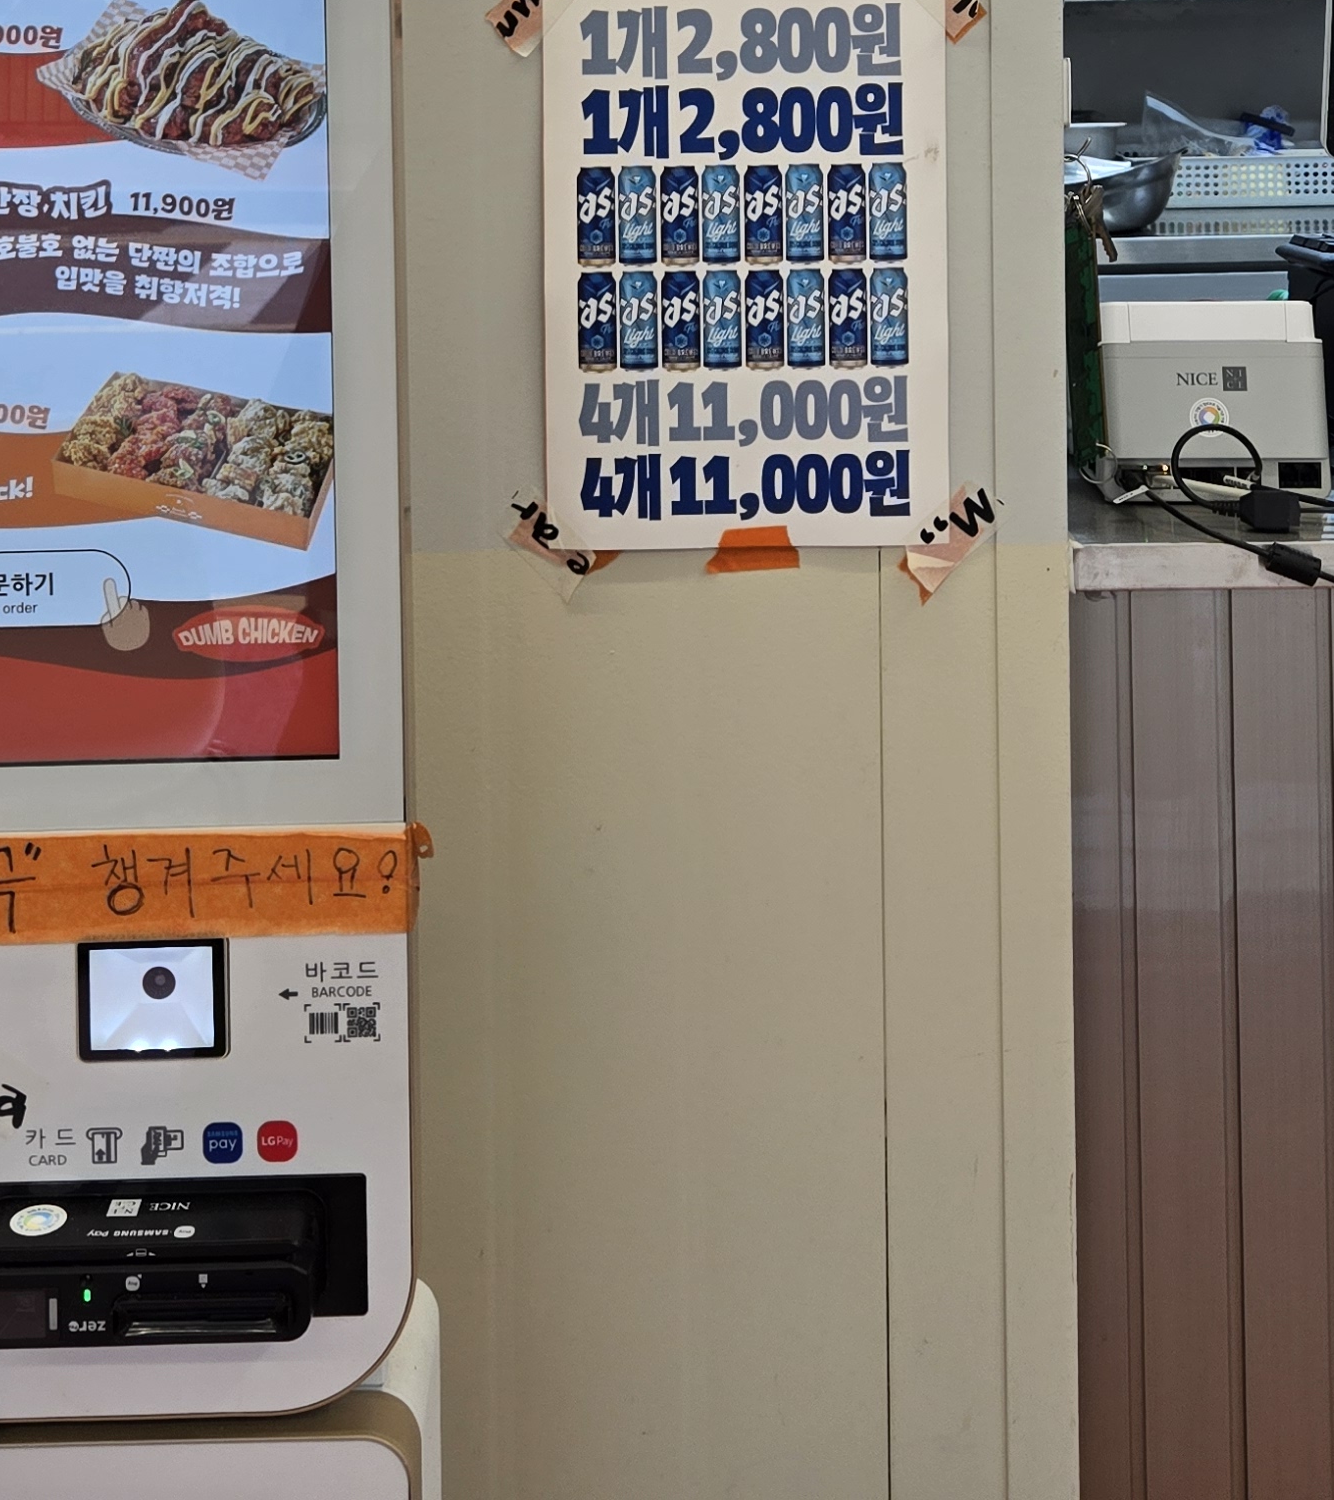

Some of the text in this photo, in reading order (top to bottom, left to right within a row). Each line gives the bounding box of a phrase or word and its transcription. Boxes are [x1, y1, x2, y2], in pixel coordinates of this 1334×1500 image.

[579, 2, 903, 81] 1개 2,800원
[581, 81, 904, 160] 1개 2,800원
[50, 185, 109, 220] 치킨
[130, 192, 236, 220] 11,900원
[71, 236, 120, 263] 없는
[128, 241, 201, 274] 단짠의
[209, 251, 305, 279] 조합으로
[54, 266, 240, 309] 입맛을 취향저격!
[1176, 372, 1218, 386] NICE
[578, 375, 909, 447] 4개 11,000원
[579, 449, 912, 522] 4개 11,000원
[3, 602, 38, 615] order
[179, 618, 319, 646] DUMB CHICKEN
[305, 962, 379, 982] 바코드
[311, 986, 372, 998] BARCODE
[208, 1136, 238, 1152] pay
[29, 1155, 67, 1166] CARD
[149, 1201, 190, 1211] NICE
